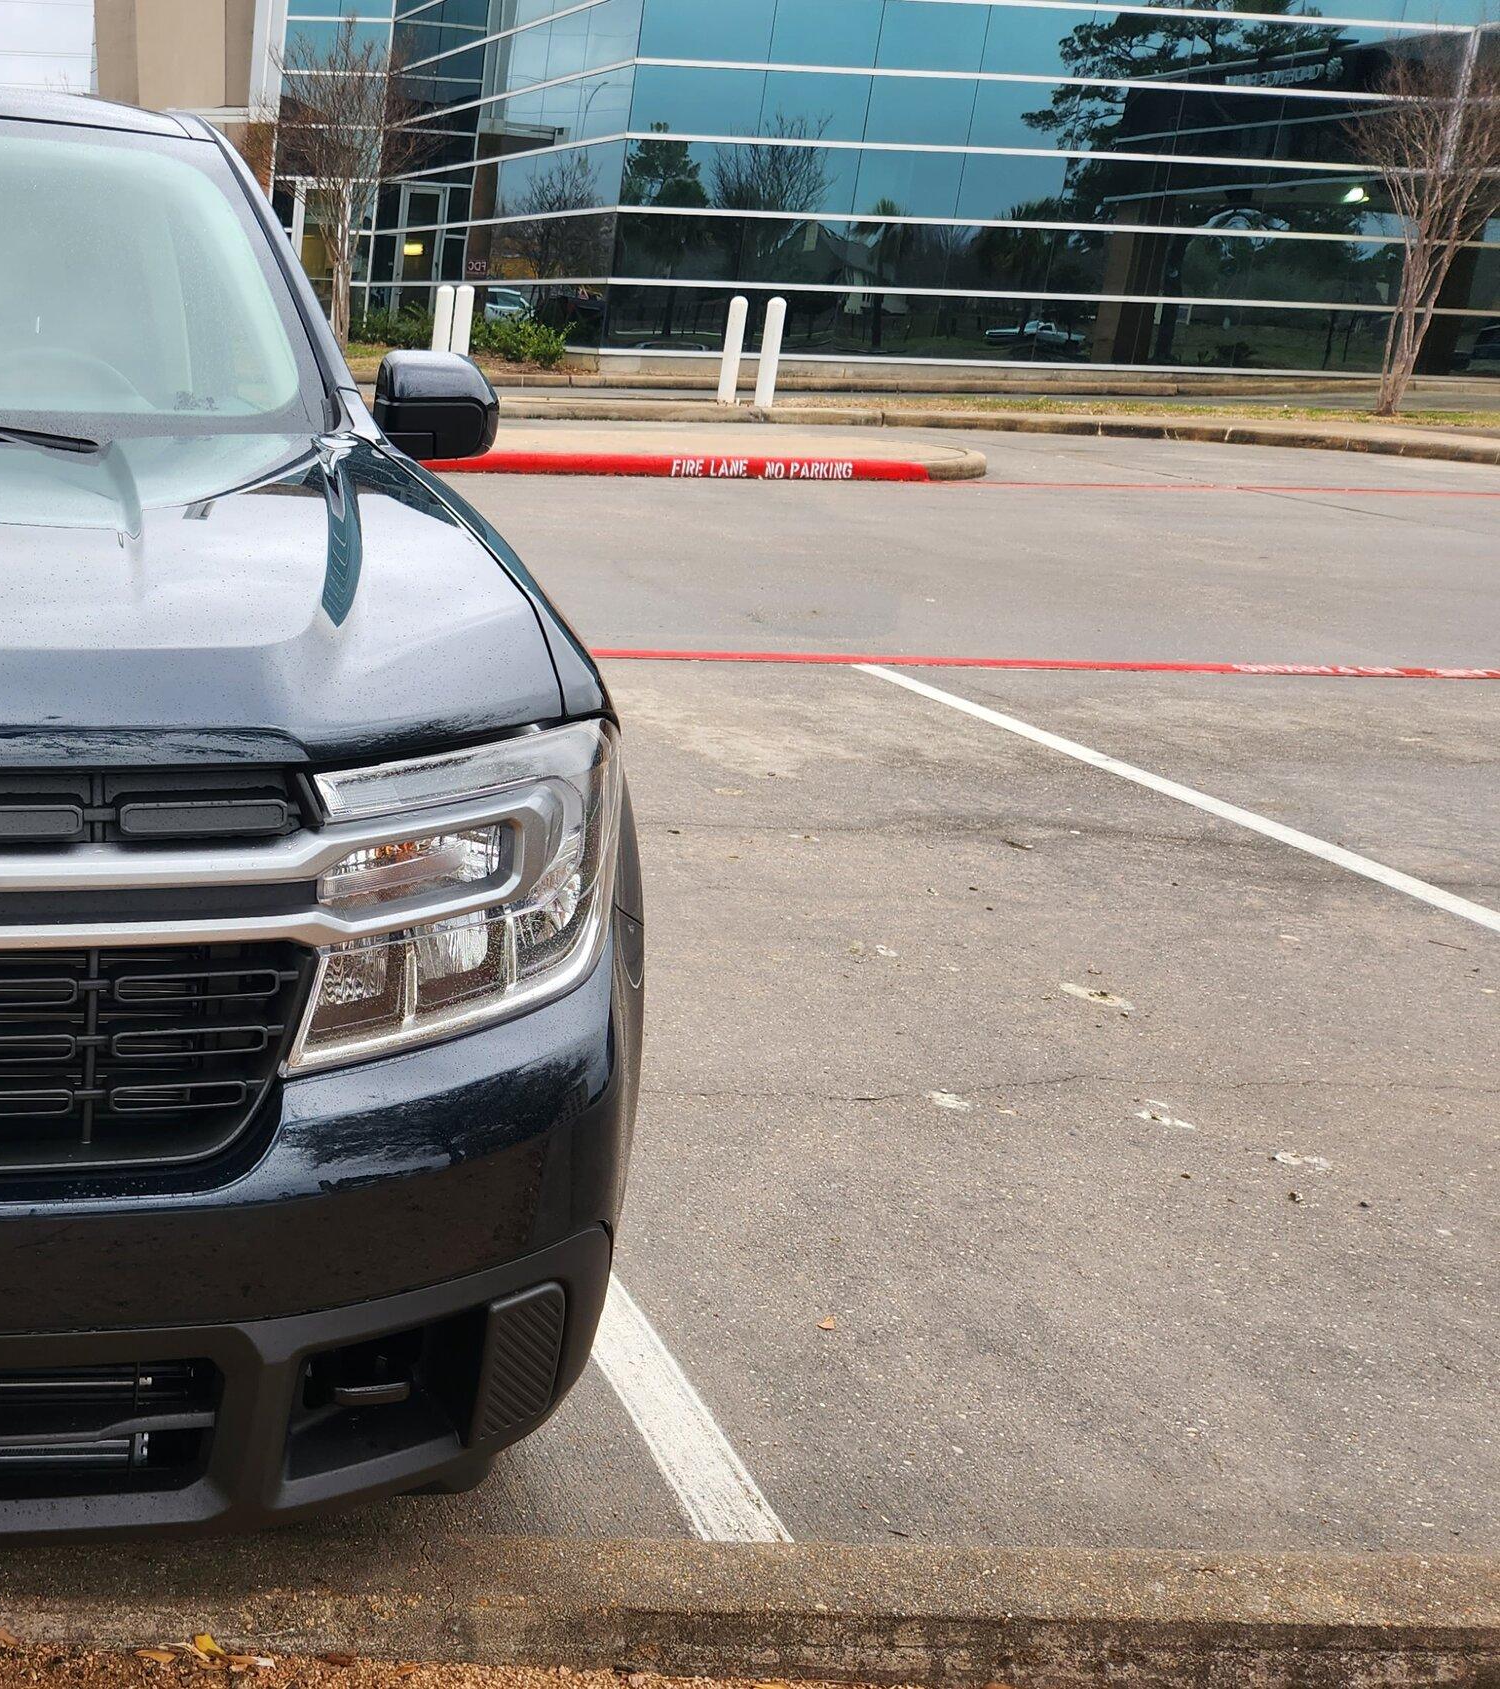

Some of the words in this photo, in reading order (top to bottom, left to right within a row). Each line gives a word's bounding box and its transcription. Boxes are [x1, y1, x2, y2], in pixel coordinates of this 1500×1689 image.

[671, 459, 703, 477] FIRE
[710, 459, 749, 477] LANE
[765, 461, 785, 479] NO
[790, 461, 853, 479] PARKING
